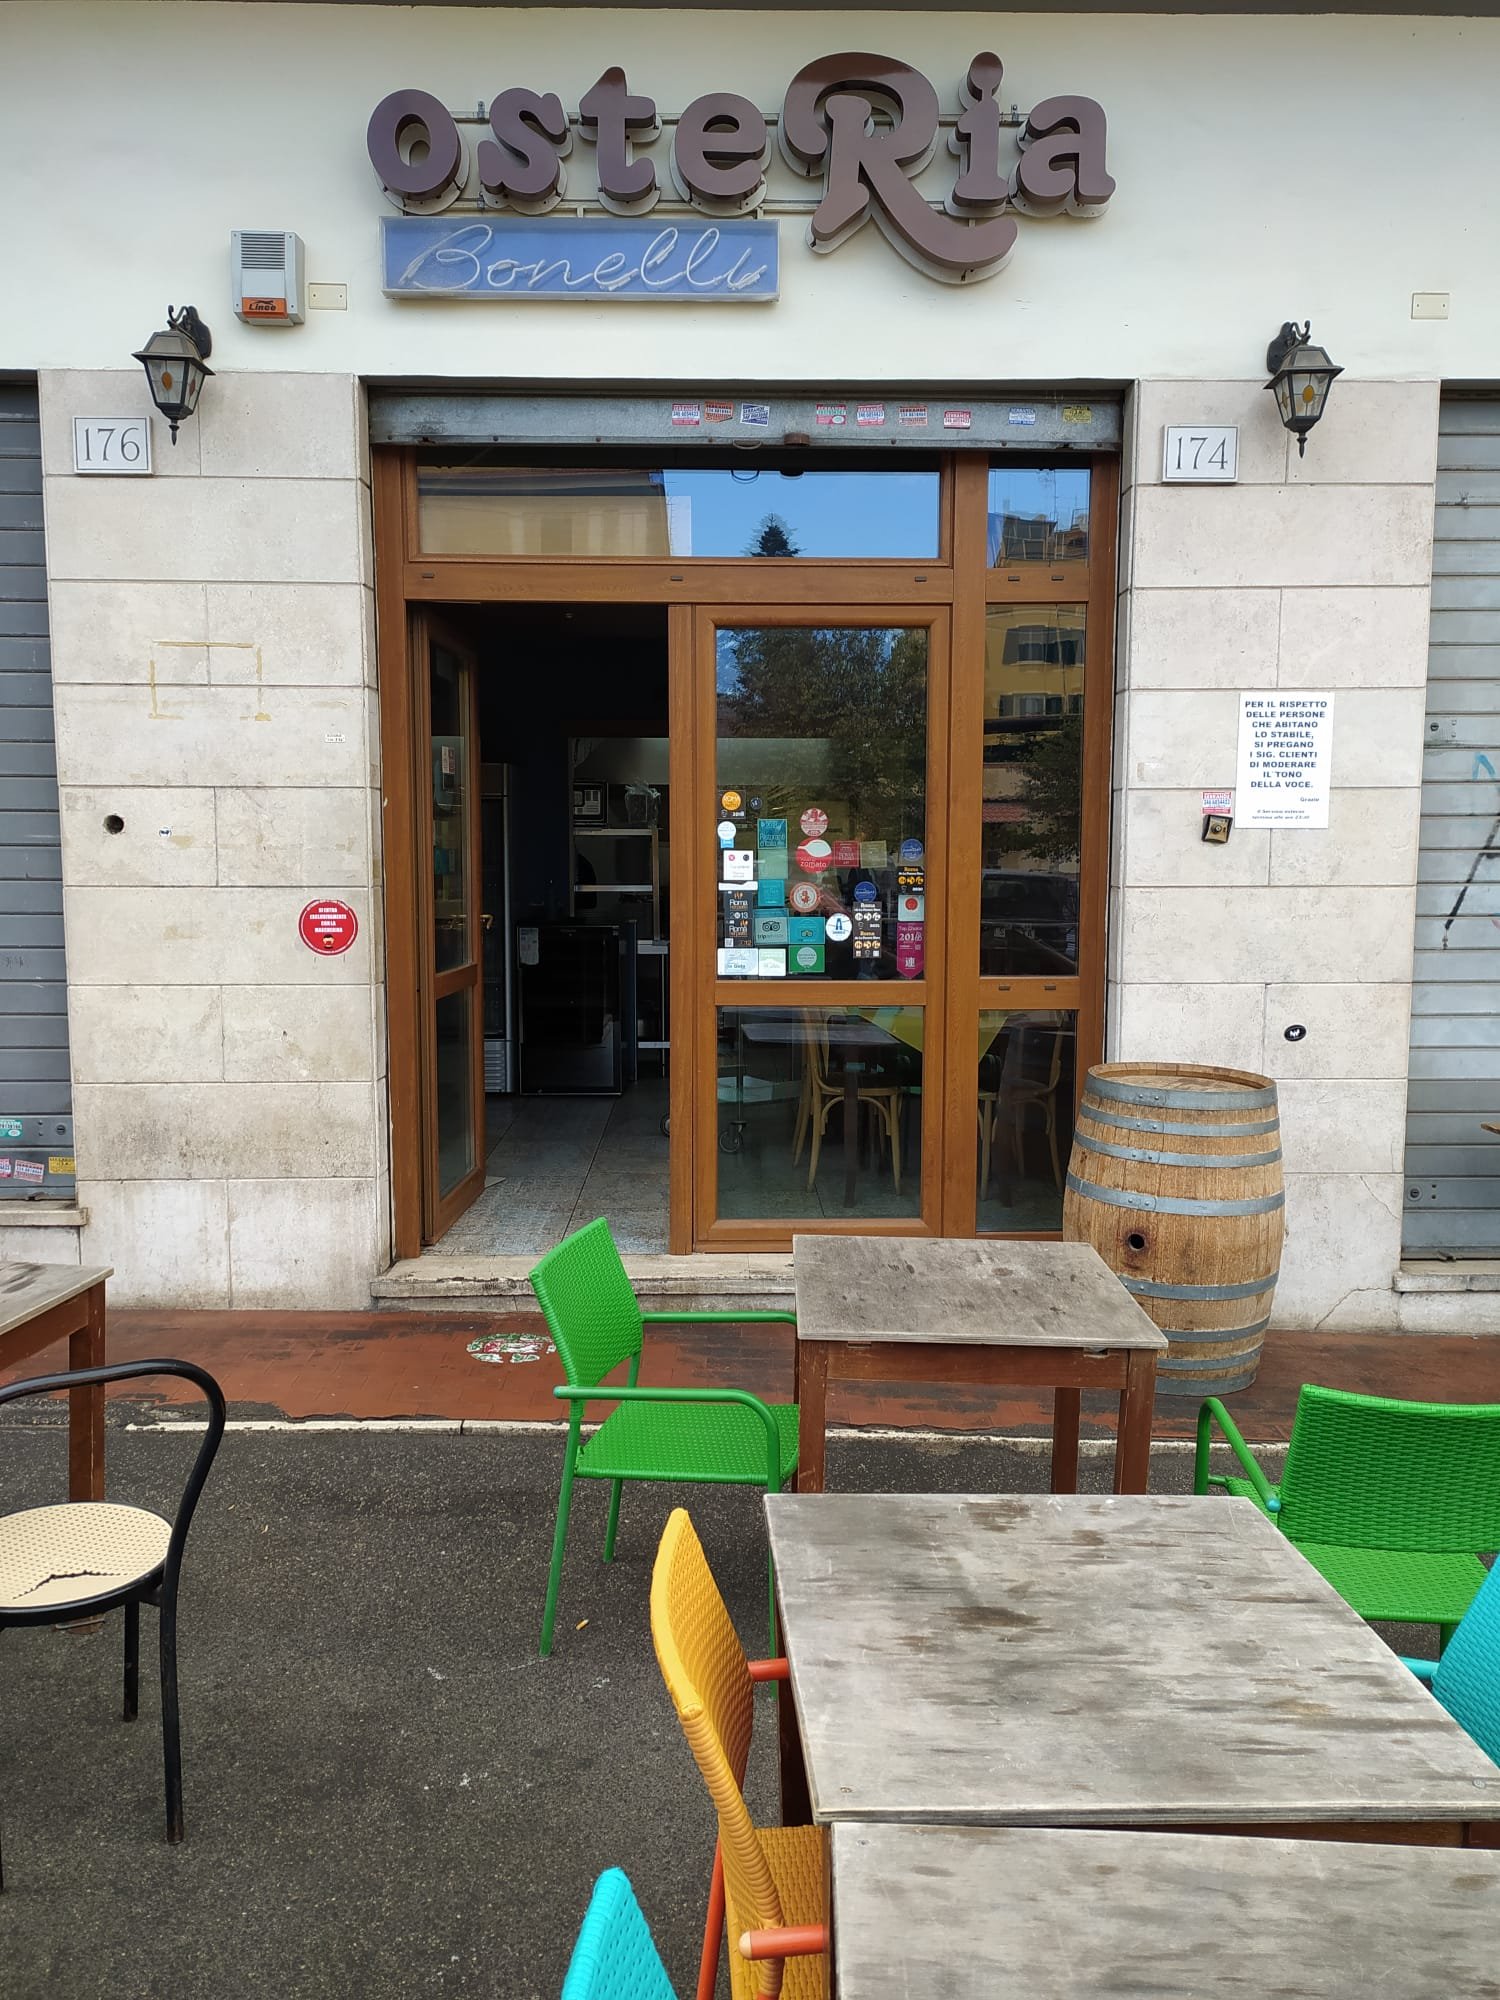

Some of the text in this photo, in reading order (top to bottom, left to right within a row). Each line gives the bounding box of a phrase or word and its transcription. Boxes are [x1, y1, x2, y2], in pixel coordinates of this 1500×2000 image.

[367, 51, 1116, 280] osteRia
[84, 426, 141, 463] 176
[1175, 435, 1230, 471] 174
[1271, 731, 1314, 739] STABILE,
